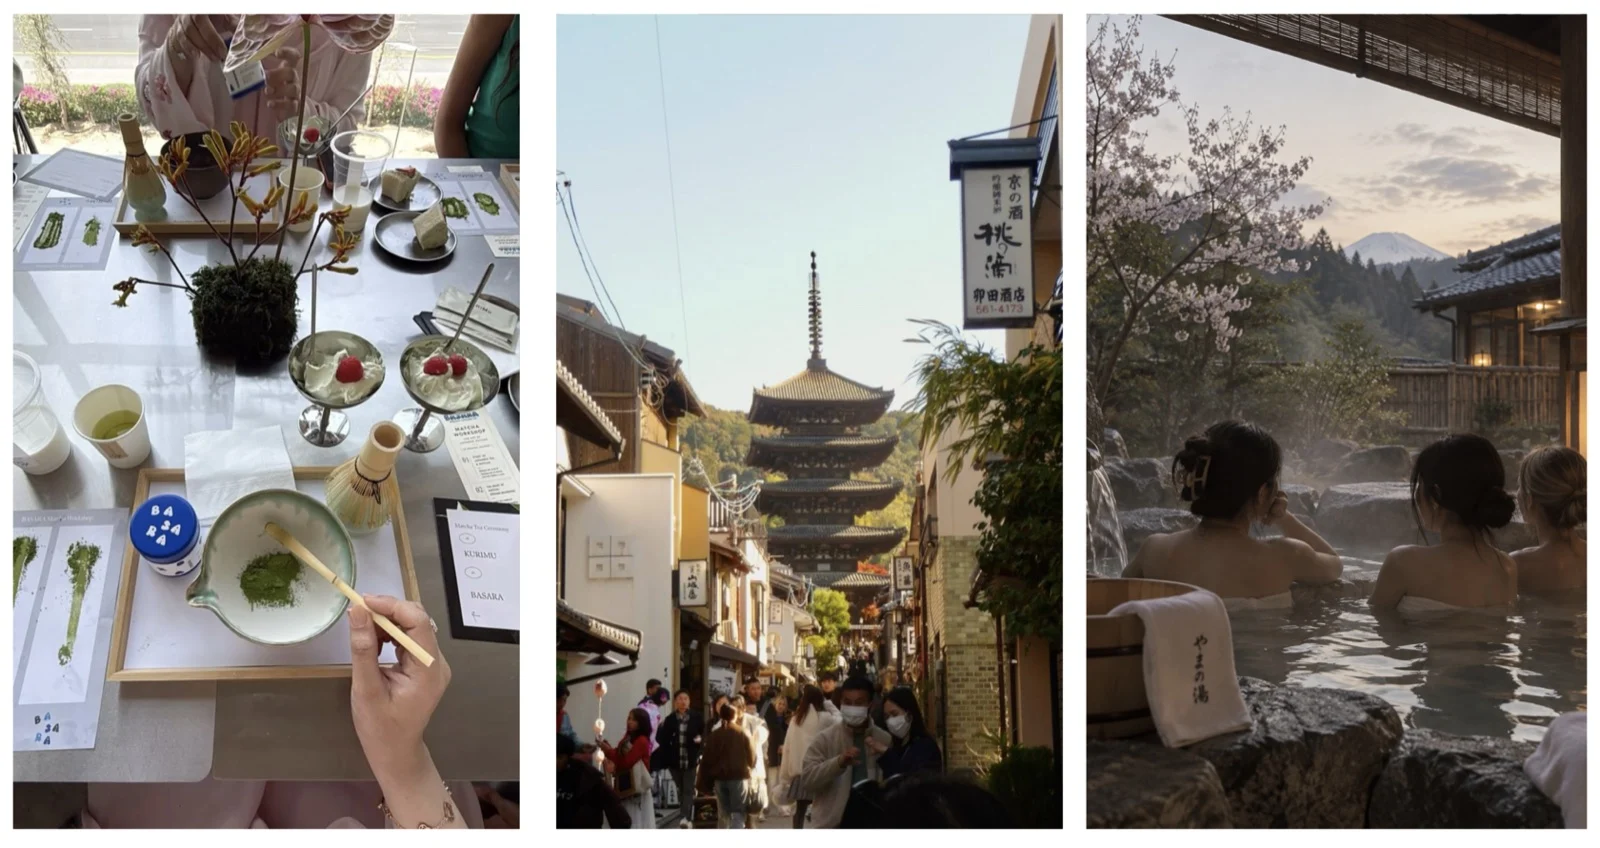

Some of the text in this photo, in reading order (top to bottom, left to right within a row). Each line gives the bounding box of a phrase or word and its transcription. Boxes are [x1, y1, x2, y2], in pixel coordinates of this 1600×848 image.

[1007, 174, 1023, 220] 京の酒
[975, 304, 1024, 314] 561-4173
[453, 429, 486, 437] WORKSHOP
[454, 424, 480, 432] MATCHA
[454, 522, 473, 530] Matcha
[463, 550, 497, 560] KURIMU
[470, 591, 504, 601] BASARA
[1193, 633, 1209, 704] やまの湯
